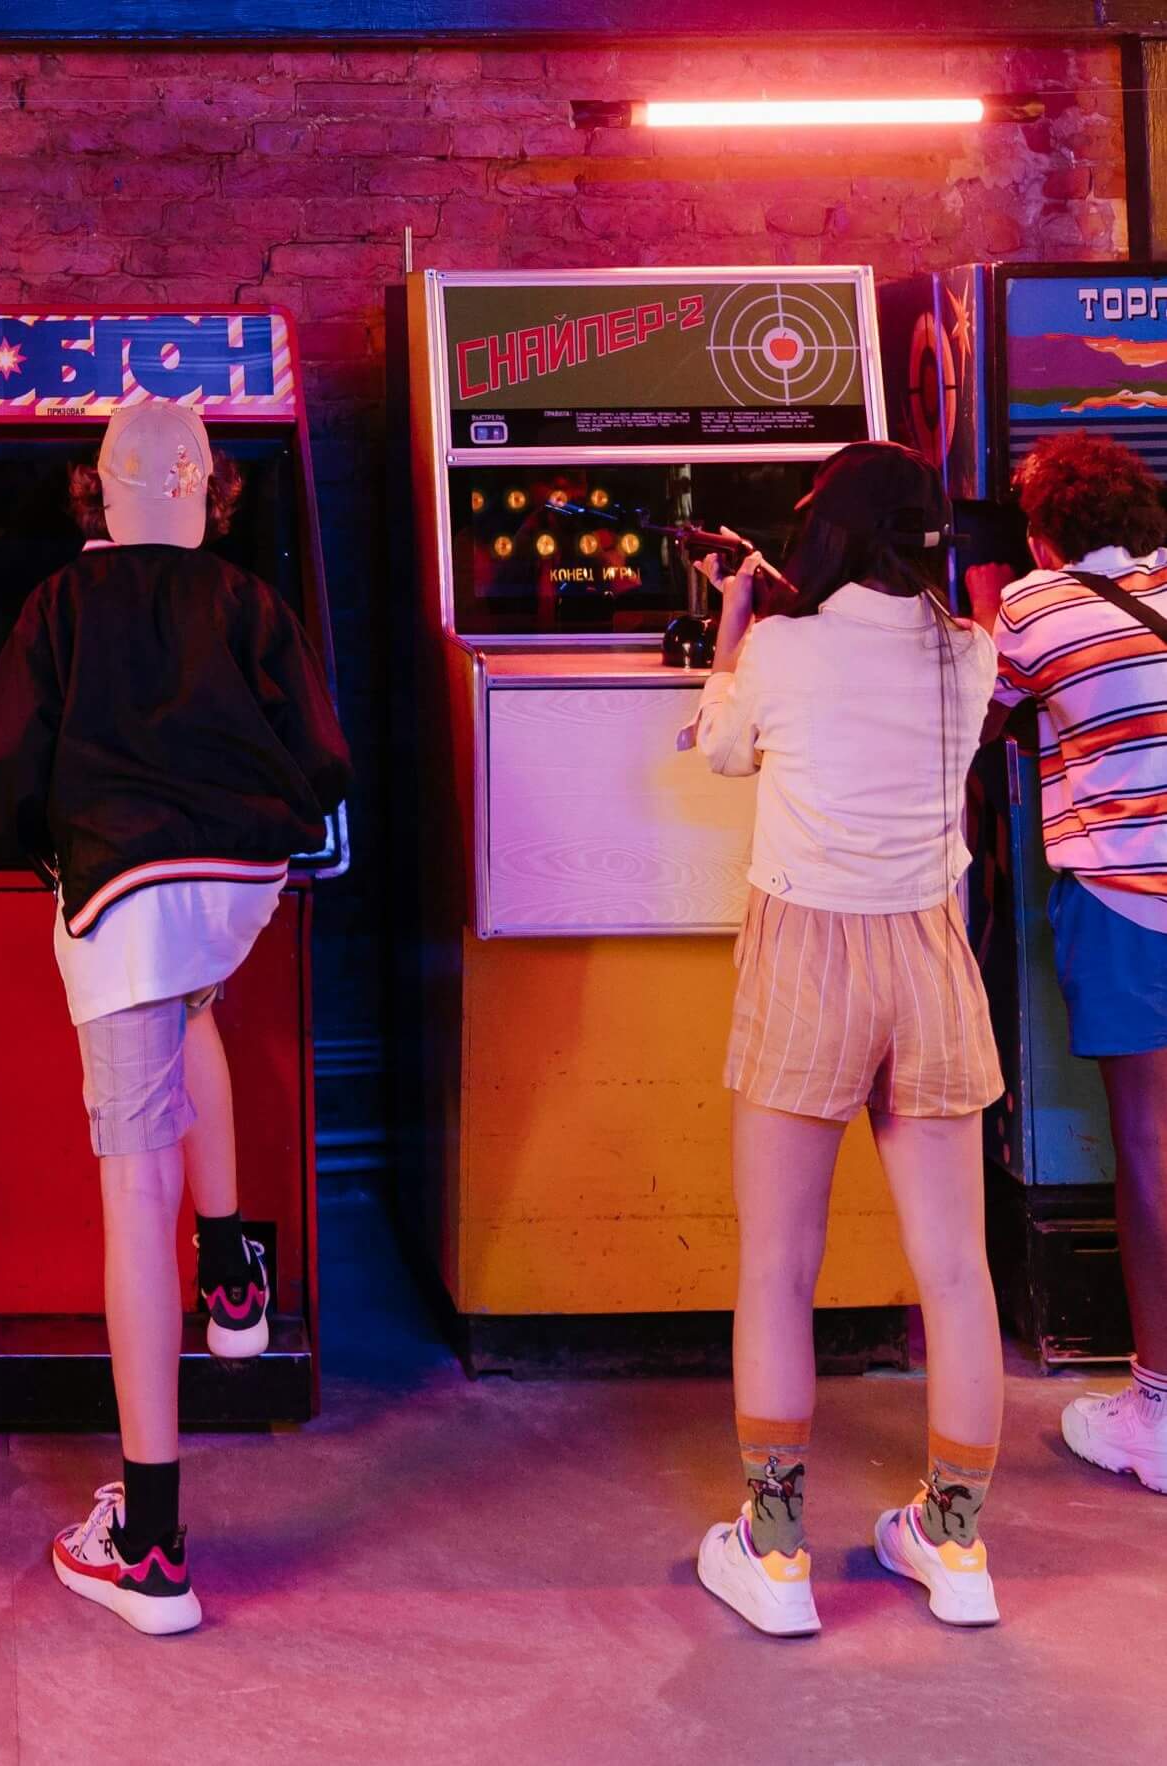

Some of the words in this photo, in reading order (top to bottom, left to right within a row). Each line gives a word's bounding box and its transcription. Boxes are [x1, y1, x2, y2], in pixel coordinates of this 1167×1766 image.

[1078, 287, 1167, 320] ТОРП
[455, 294, 706, 400] СНАЙПЕР-2
[549, 567, 594, 582] КОНЕЦ
